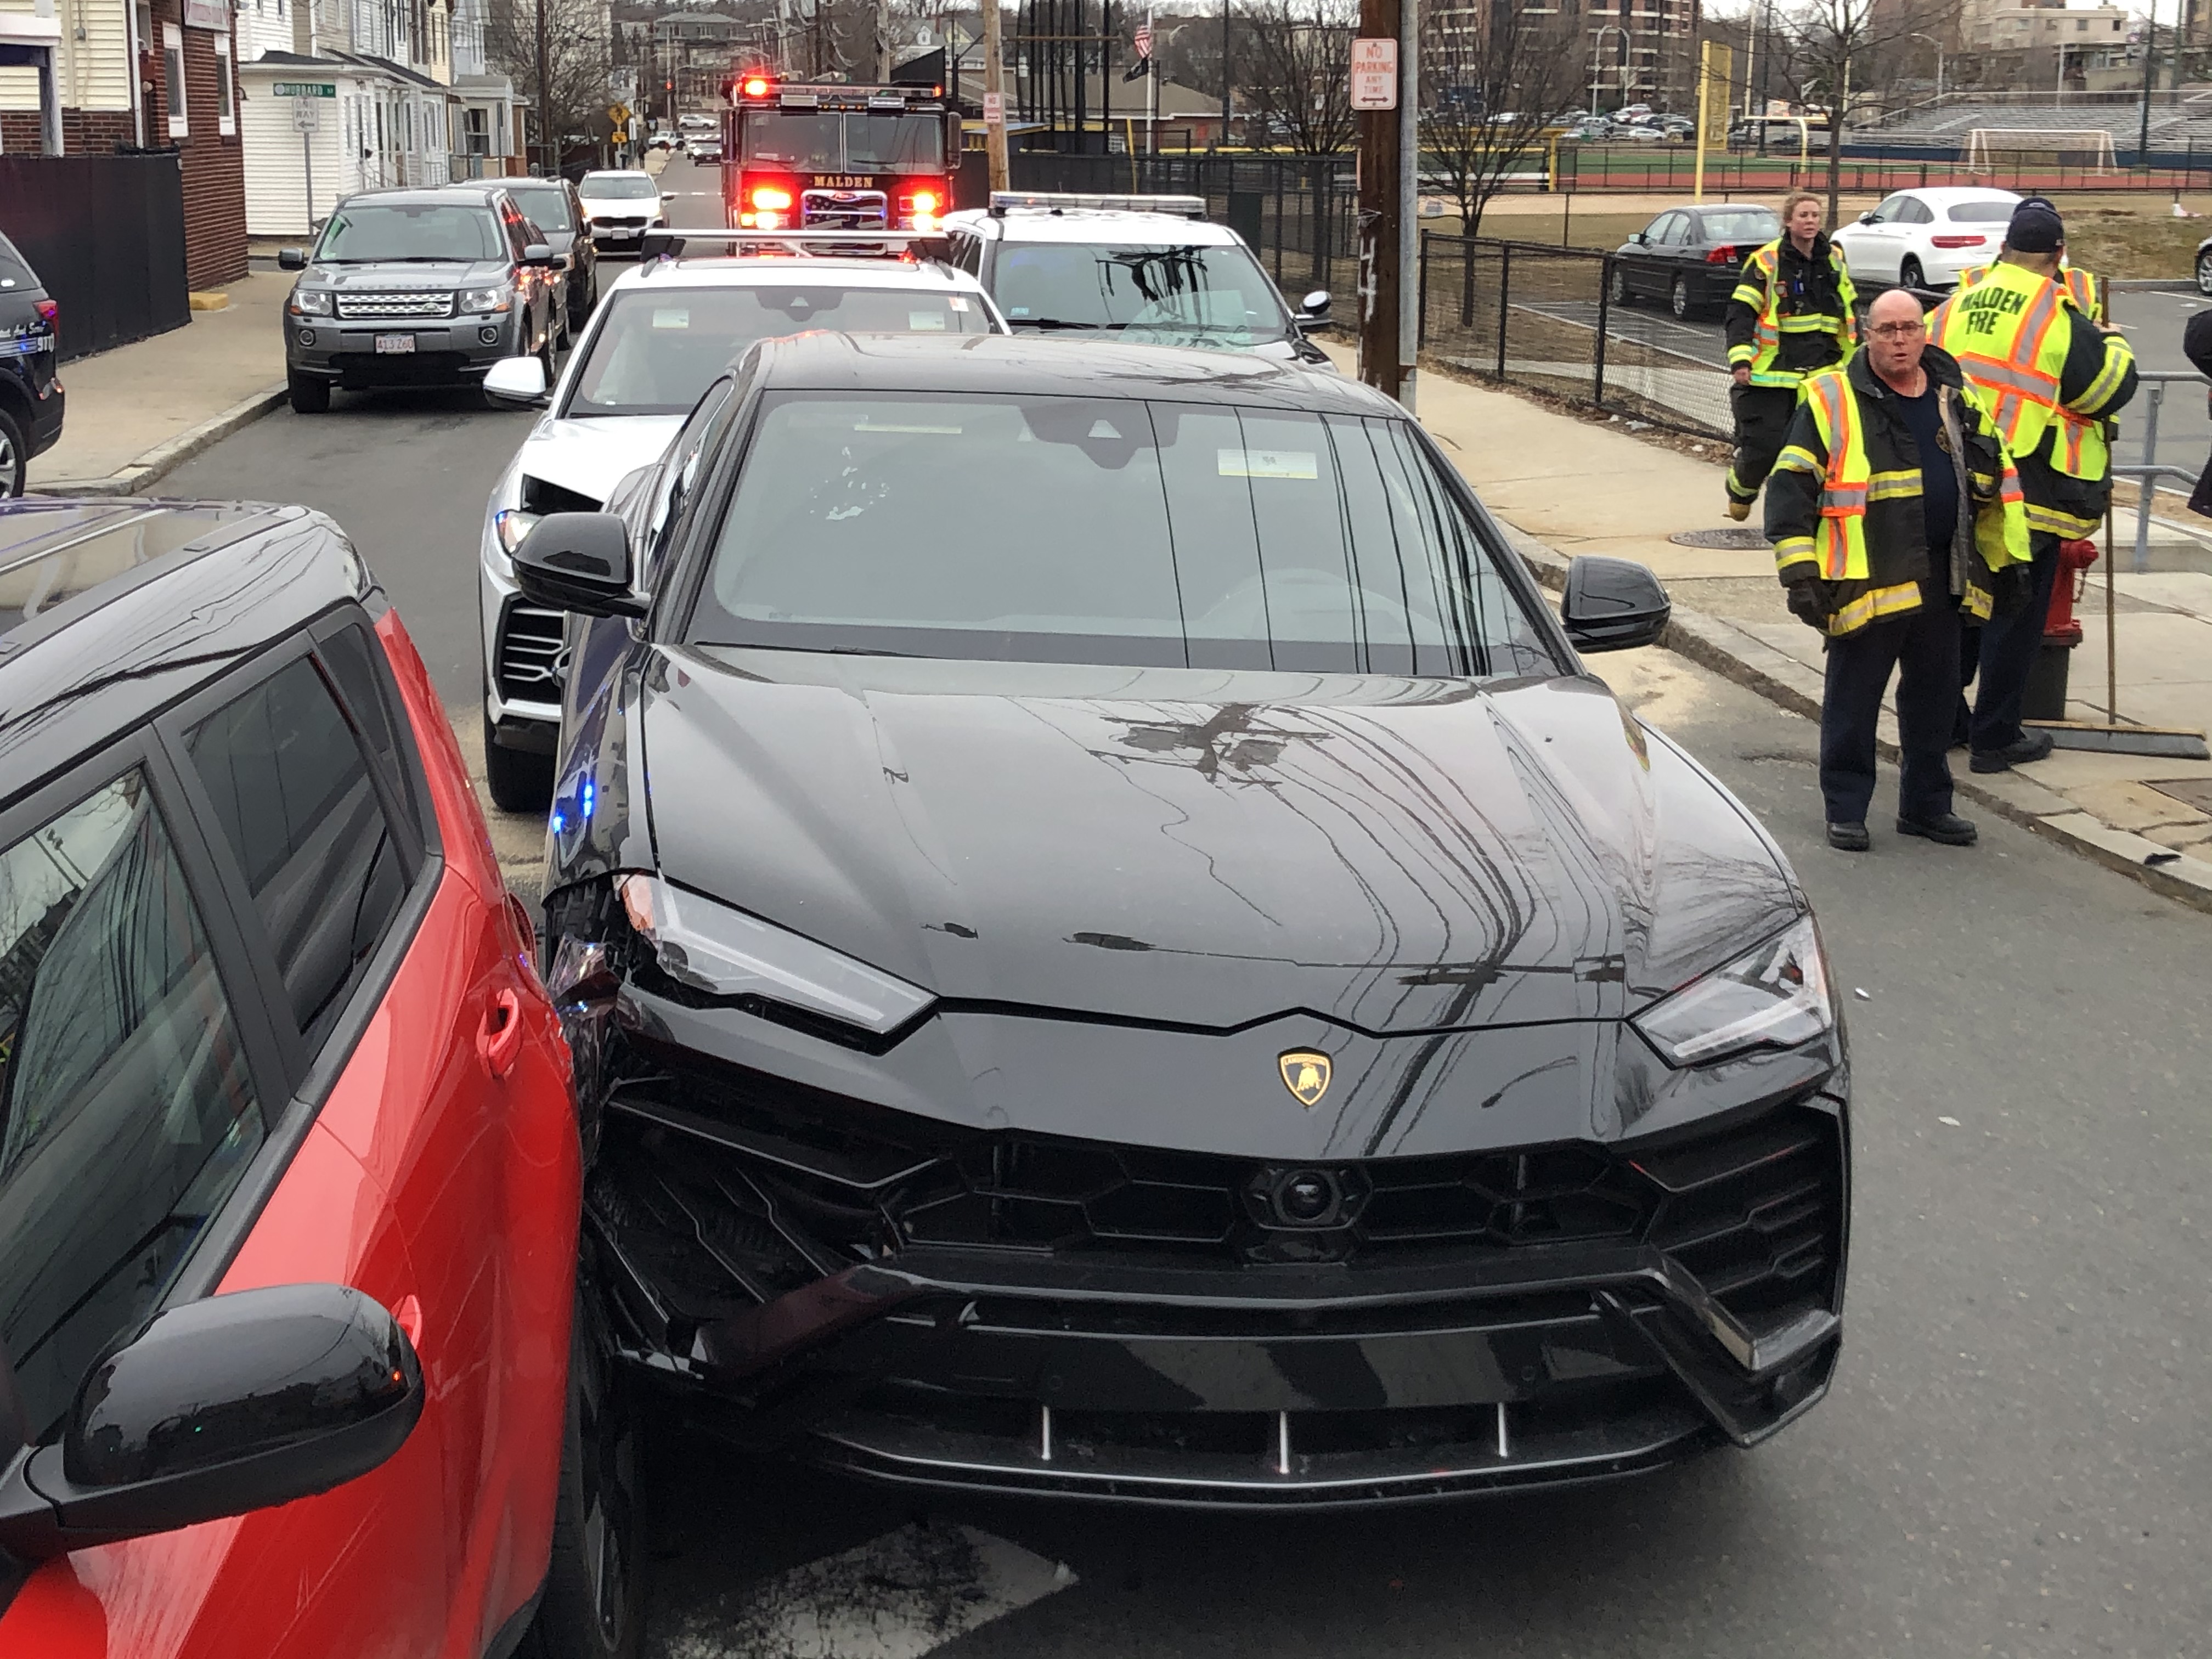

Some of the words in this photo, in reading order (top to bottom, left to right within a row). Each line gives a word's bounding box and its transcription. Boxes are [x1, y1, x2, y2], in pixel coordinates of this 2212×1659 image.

[1366, 46, 1383, 58] NO
[1354, 61, 1393, 74] PARKING
[285, 84, 323, 96] HUBBARD
[1364, 86, 1383, 94] TIME
[296, 110, 315, 119] WAY
[814, 176, 873, 188] MALDEN
[1957, 286, 2029, 315] MALDEN
